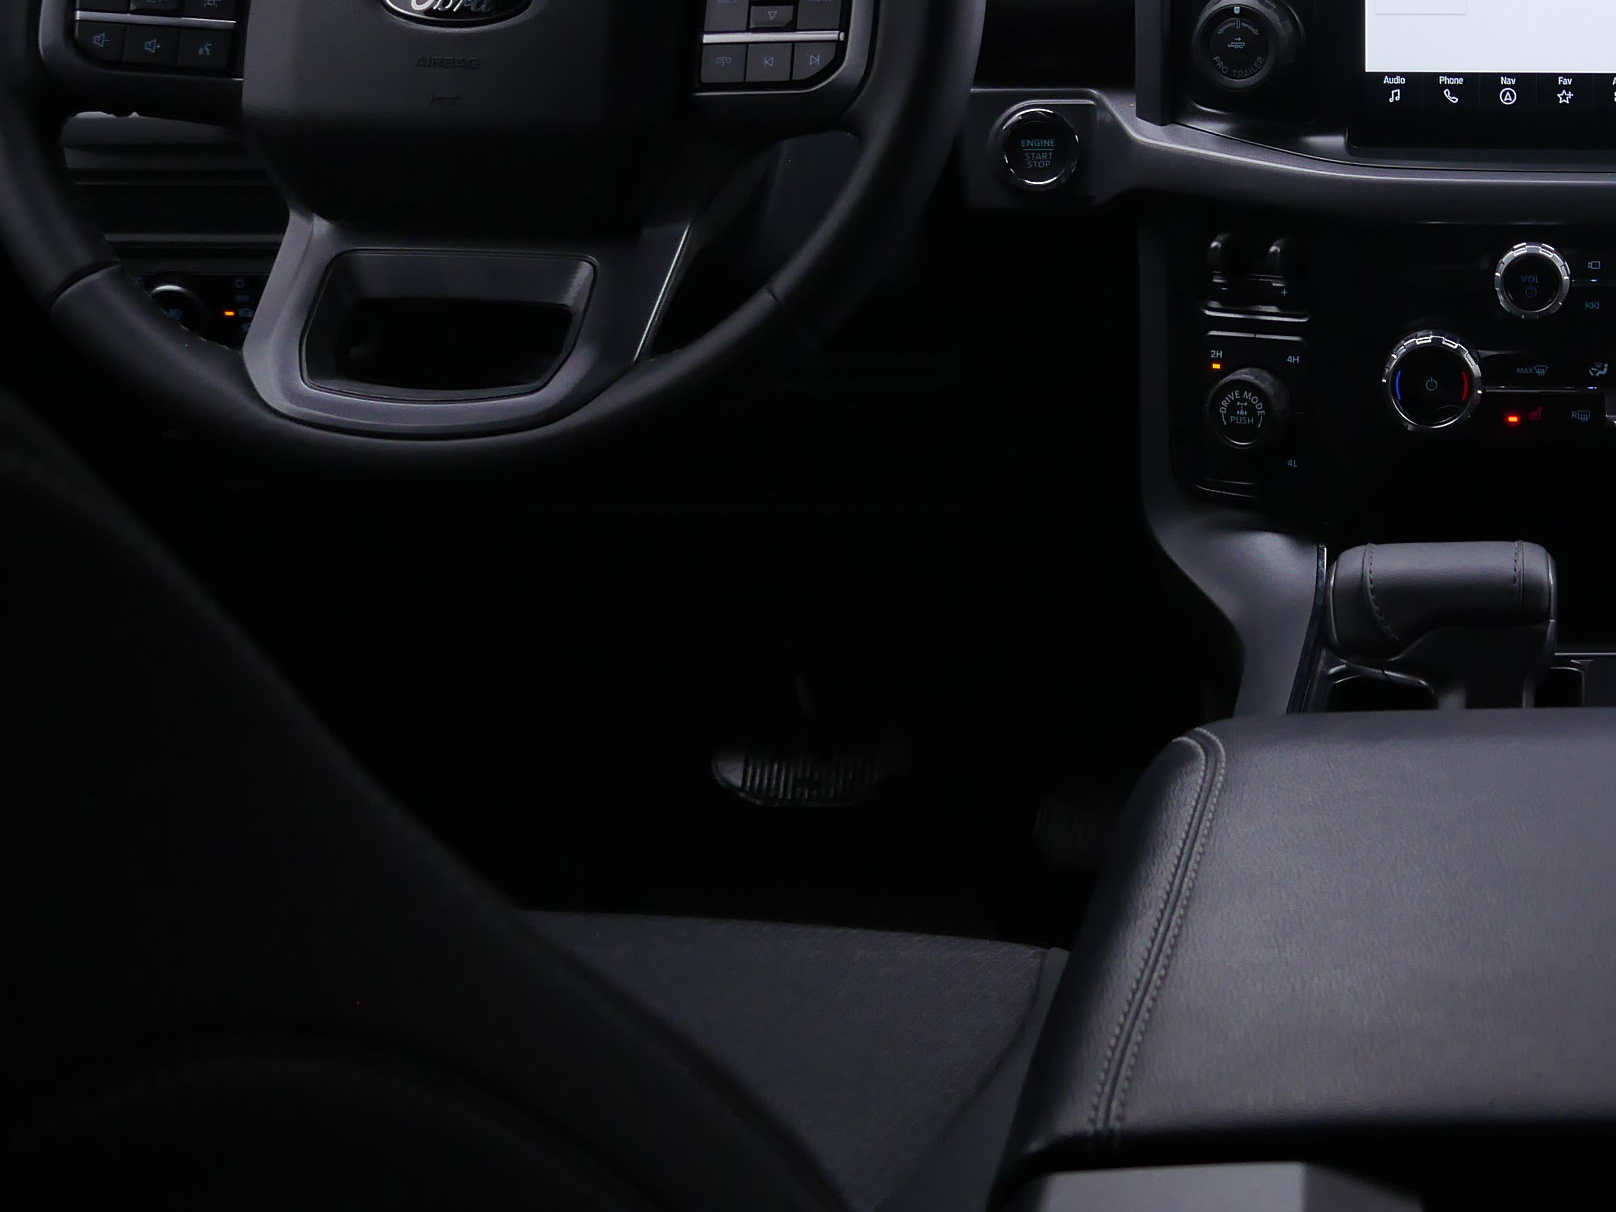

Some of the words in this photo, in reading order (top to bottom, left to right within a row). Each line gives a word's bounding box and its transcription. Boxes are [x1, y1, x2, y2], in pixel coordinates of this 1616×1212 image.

[414, 55, 481, 70] AIRBAG
[1383, 75, 1406, 85] Audio
[1438, 75, 1464, 85] Phone
[1500, 76, 1517, 85] Nav
[1558, 76, 1573, 85] Fav
[1020, 139, 1056, 147] ENGINE
[1024, 152, 1053, 160] START
[1026, 160, 1051, 168] STOP
[1520, 274, 1541, 284] VOL
[1210, 349, 1223, 359] 2H
[1286, 355, 1300, 365] 4H
[1515, 366, 1534, 374] MAX
[1219, 389, 1242, 415] DRIVE
[1242, 389, 1266, 416] MODE
[1229, 415, 1255, 425] PUSH
[1286, 459, 1299, 468] 4L
